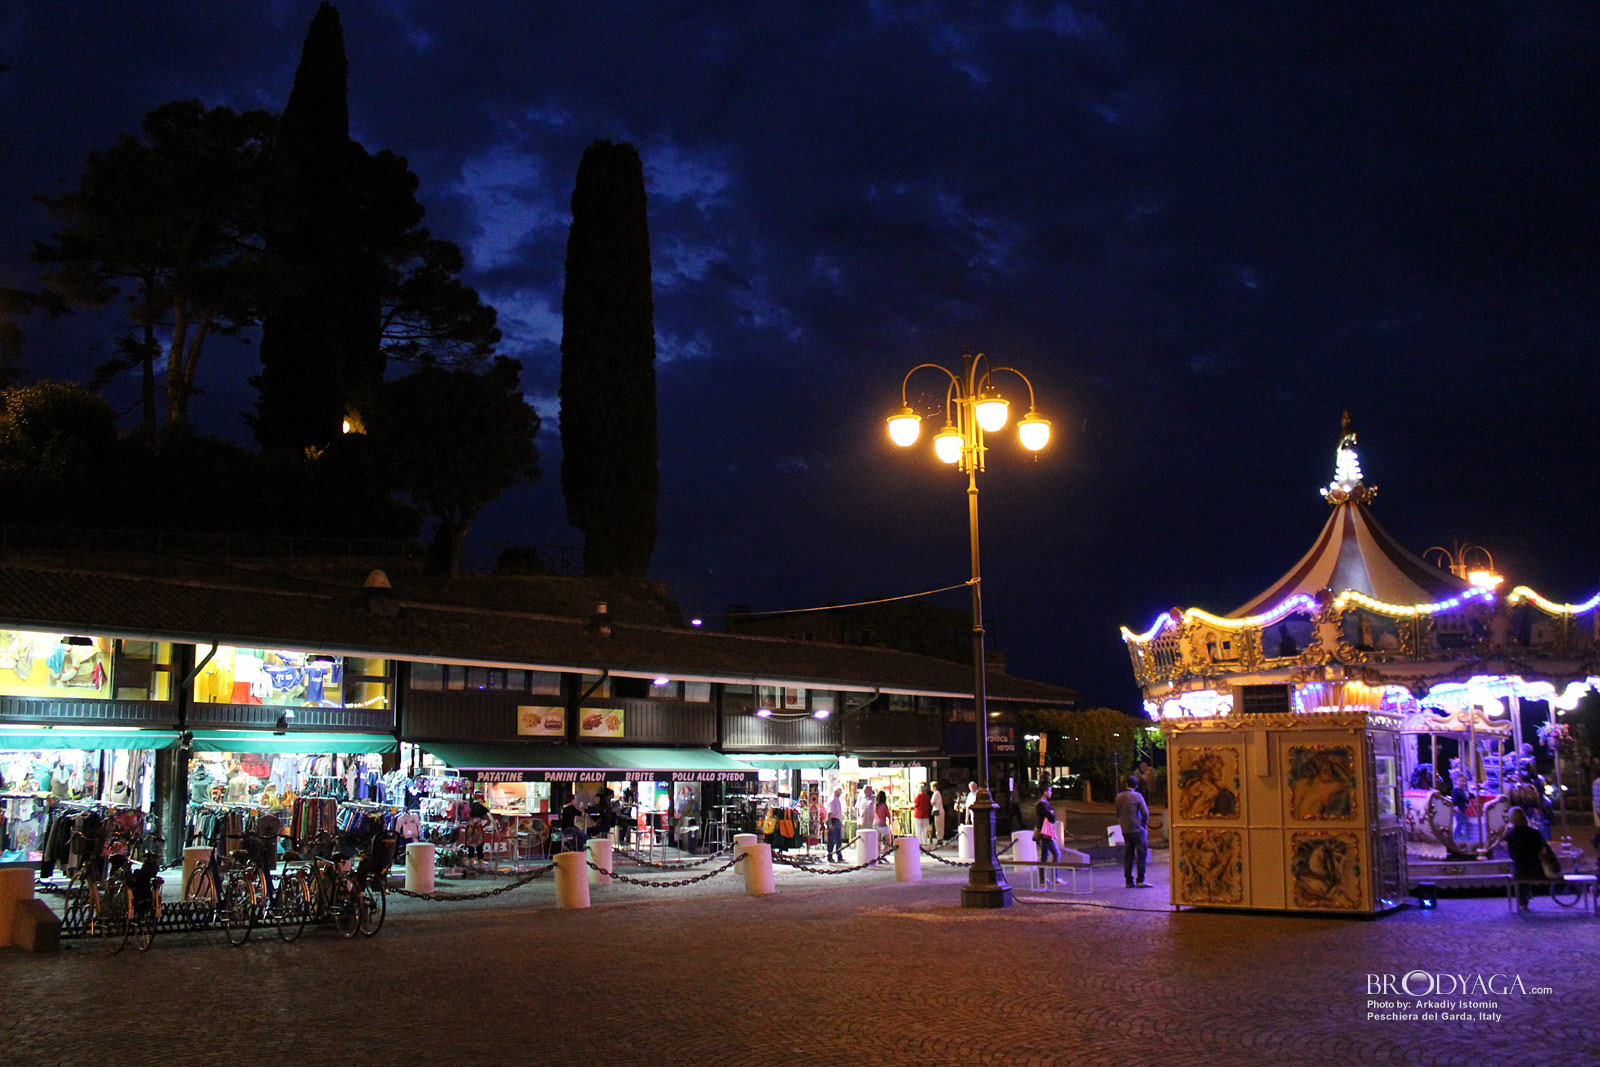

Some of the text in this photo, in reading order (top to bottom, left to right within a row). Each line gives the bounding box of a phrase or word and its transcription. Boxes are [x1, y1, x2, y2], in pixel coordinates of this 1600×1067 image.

[987, 734, 1008, 743] rovincia
[477, 771, 523, 782] PATATINE
[544, 771, 606, 782] PANINI CALDI
[625, 771, 655, 782] BIBITE
[672, 771, 745, 782] POLLI ALLO SPIEDO
